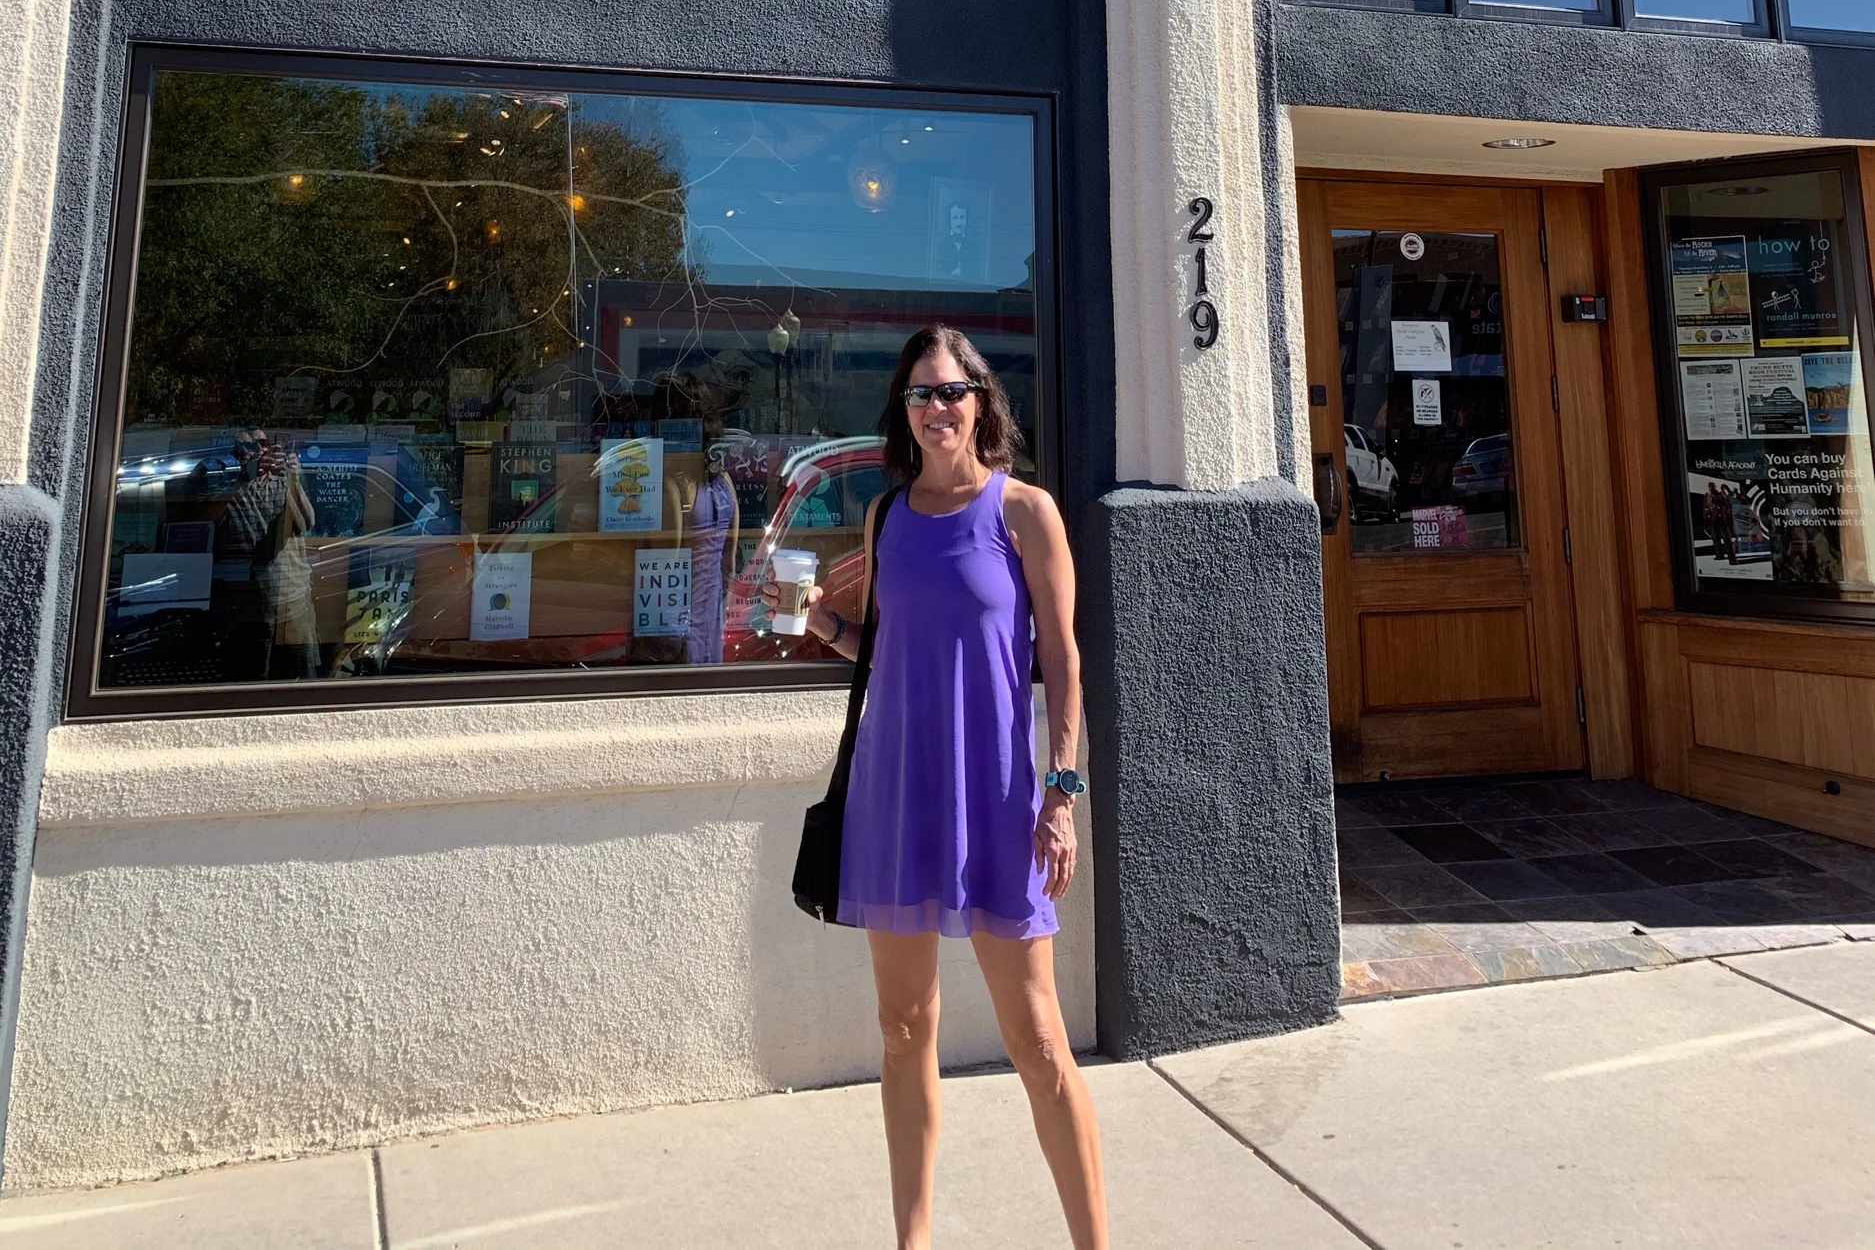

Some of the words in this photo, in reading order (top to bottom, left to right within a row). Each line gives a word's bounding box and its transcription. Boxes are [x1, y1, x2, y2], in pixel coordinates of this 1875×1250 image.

[1759, 235, 1801, 254] how
[1810, 235, 1830, 251] to
[1188, 197, 1219, 350] 219
[1766, 311, 1799, 321] randall
[1802, 311, 1837, 320] munroe
[326, 379, 362, 388] ATWOOD
[449, 410, 482, 418] SECOND
[499, 446, 552, 458] STEPHEN
[1765, 452, 1790, 465] You
[1793, 454, 1818, 464] can
[1821, 452, 1846, 466] buy
[499, 457, 552, 474] KING
[315, 472, 351, 481] COATES
[1767, 468, 1808, 480] Cards
[1810, 467, 1863, 481] Against
[325, 481, 342, 489] THE
[605, 486, 619, 494] We
[641, 485, 656, 494] Had
[1769, 482, 1833, 496] Humanity
[318, 488, 347, 496] WATER
[1411, 507, 1438, 522] MARVEL
[1772, 507, 1789, 516] But
[1791, 509, 1809, 517] you
[1811, 506, 1836, 516] don't
[1837, 506, 1861, 516] have
[497, 519, 551, 530] INSTITUTE
[1774, 517, 1781, 526] if
[1783, 518, 1800, 528] you
[1802, 517, 1827, 526] don't
[1829, 517, 1852, 526] want
[1412, 521, 1440, 536] SOLD
[1413, 534, 1441, 548] HERE
[488, 564, 515, 574] Talking
[639, 562, 658, 571] WE
[664, 561, 689, 570] ARE
[484, 582, 518, 591] Strangers
[639, 573, 688, 589] INDI
[356, 590, 409, 604] PARIS
[639, 592, 688, 608] VISI
[725, 610, 740, 618] YOU
